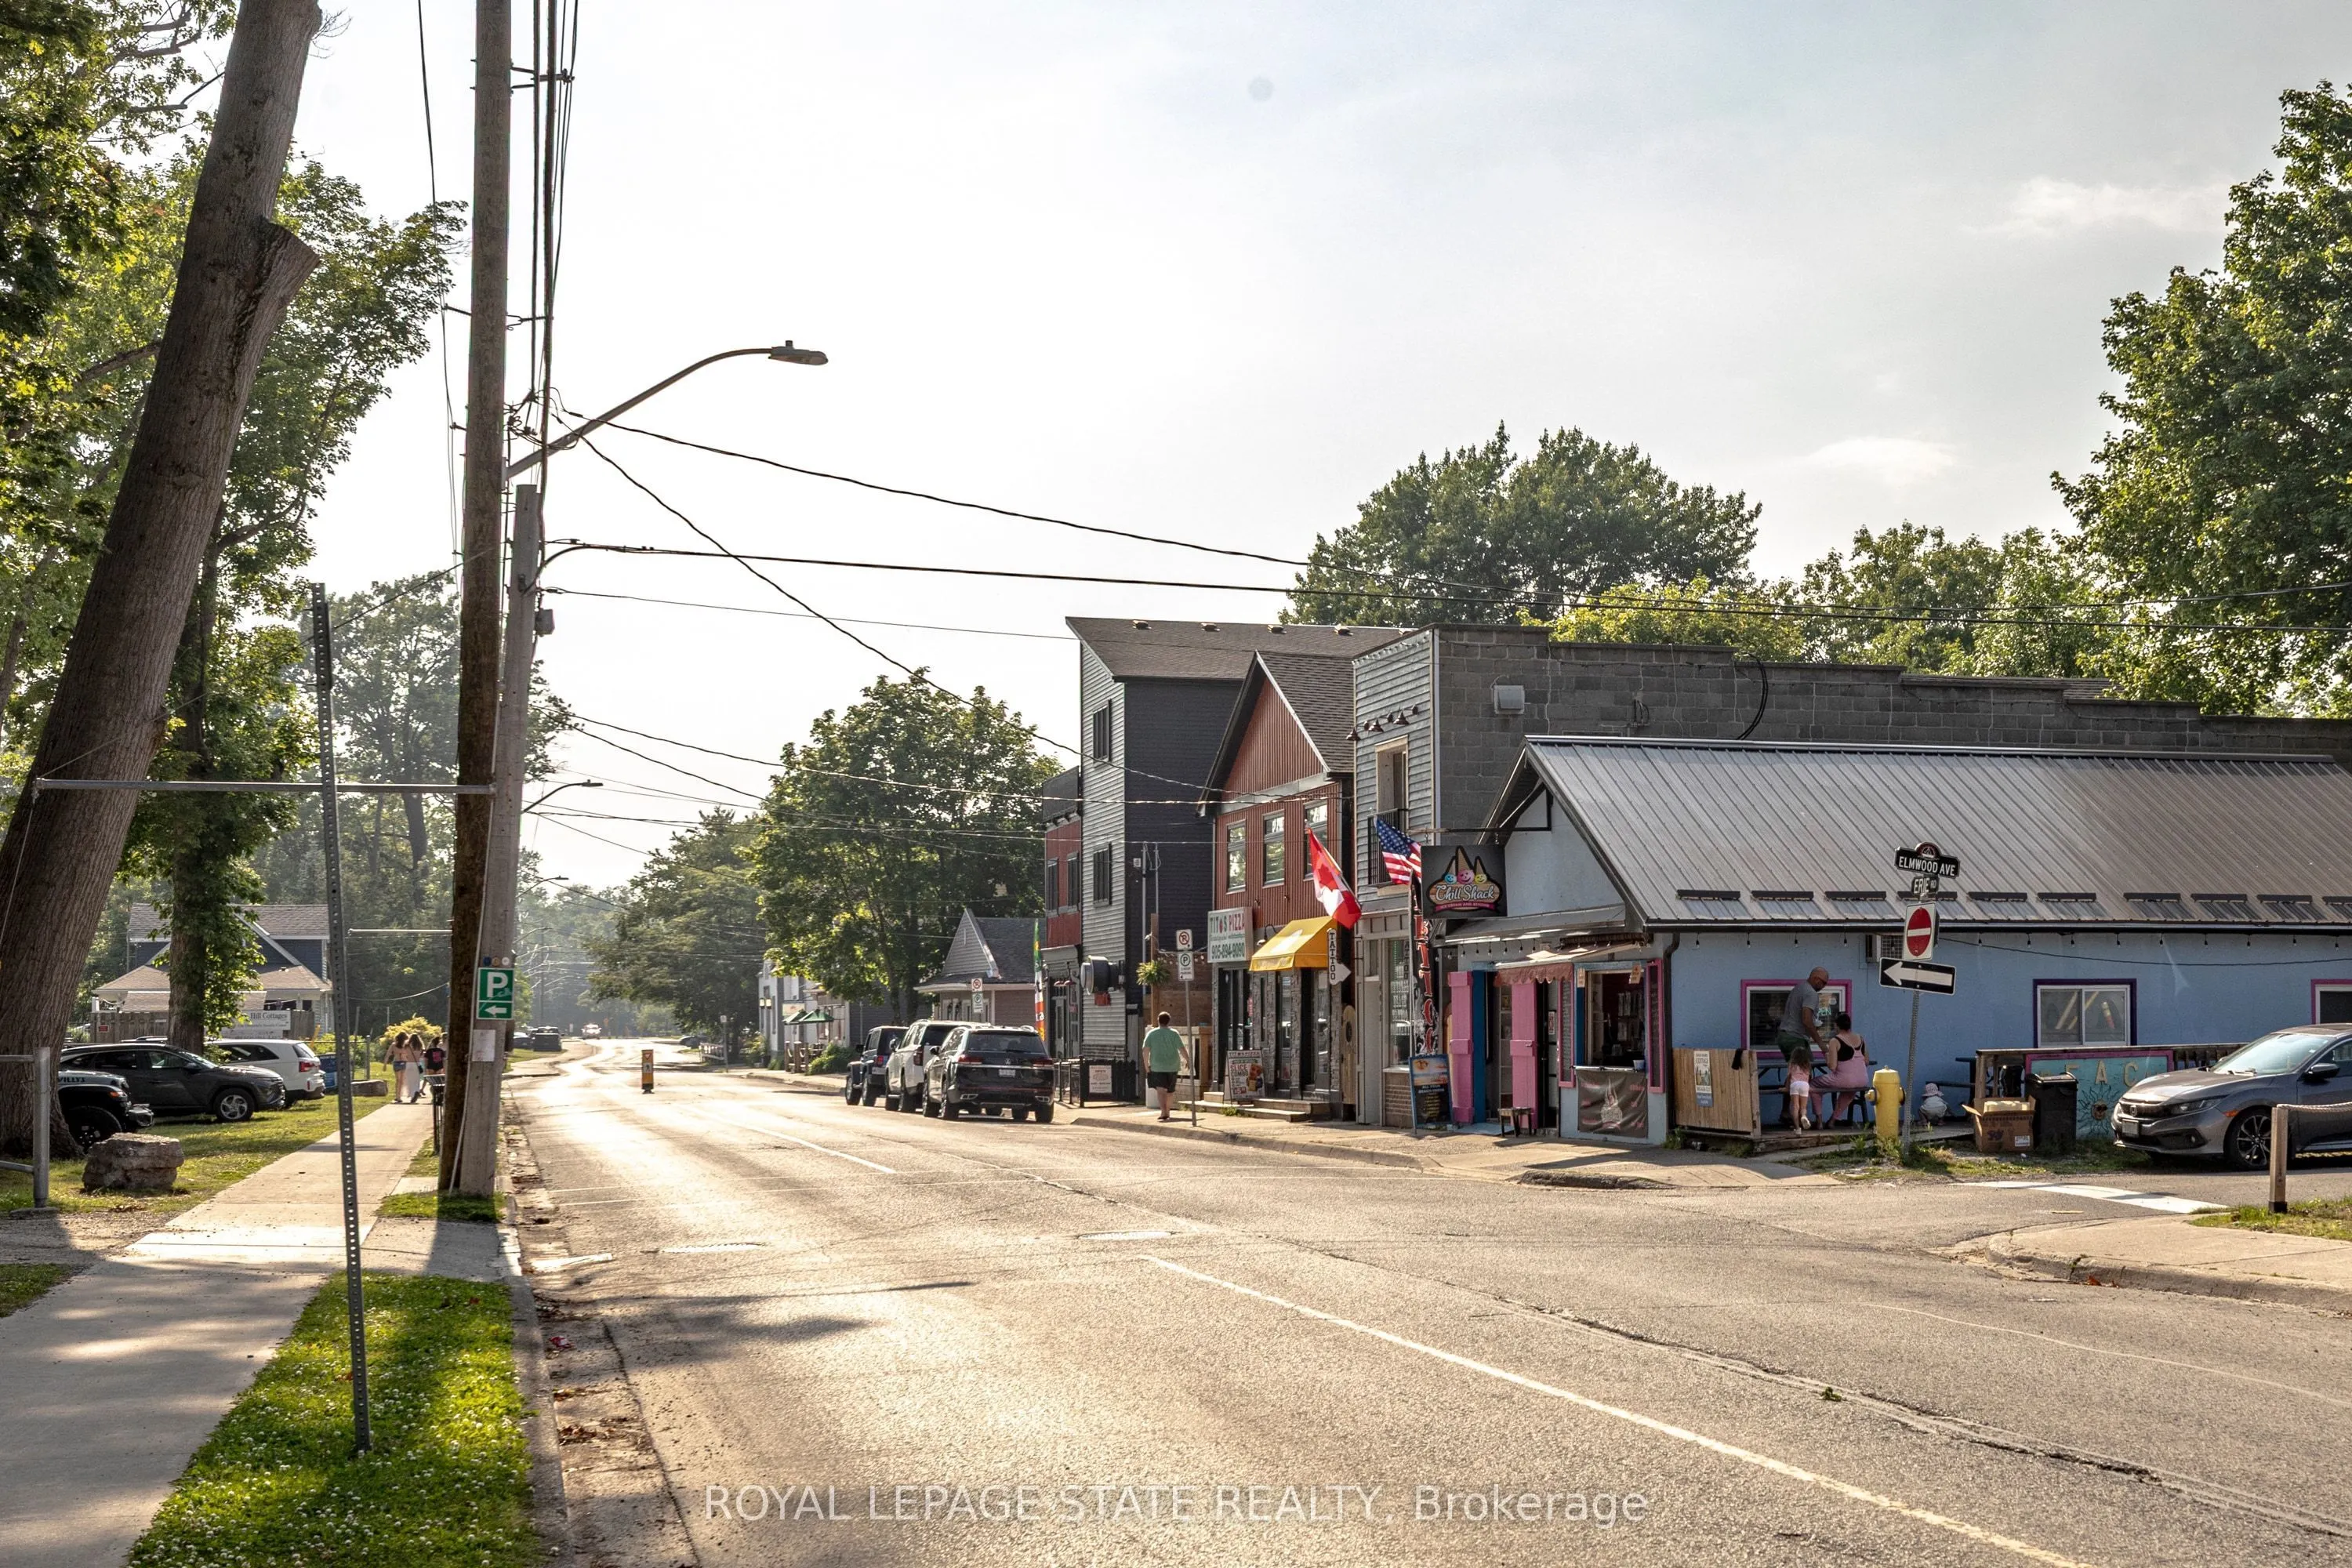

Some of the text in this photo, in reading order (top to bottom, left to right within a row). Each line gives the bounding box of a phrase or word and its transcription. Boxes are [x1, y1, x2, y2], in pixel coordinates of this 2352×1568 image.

[1898, 856, 1956, 876] ELMWOOD AVE
[1436, 884, 1494, 901] Chill Shack
[1913, 878, 1937, 894] ERIE RD
[487, 971, 509, 998] P
[263, 1012, 288, 1021] Cottages
